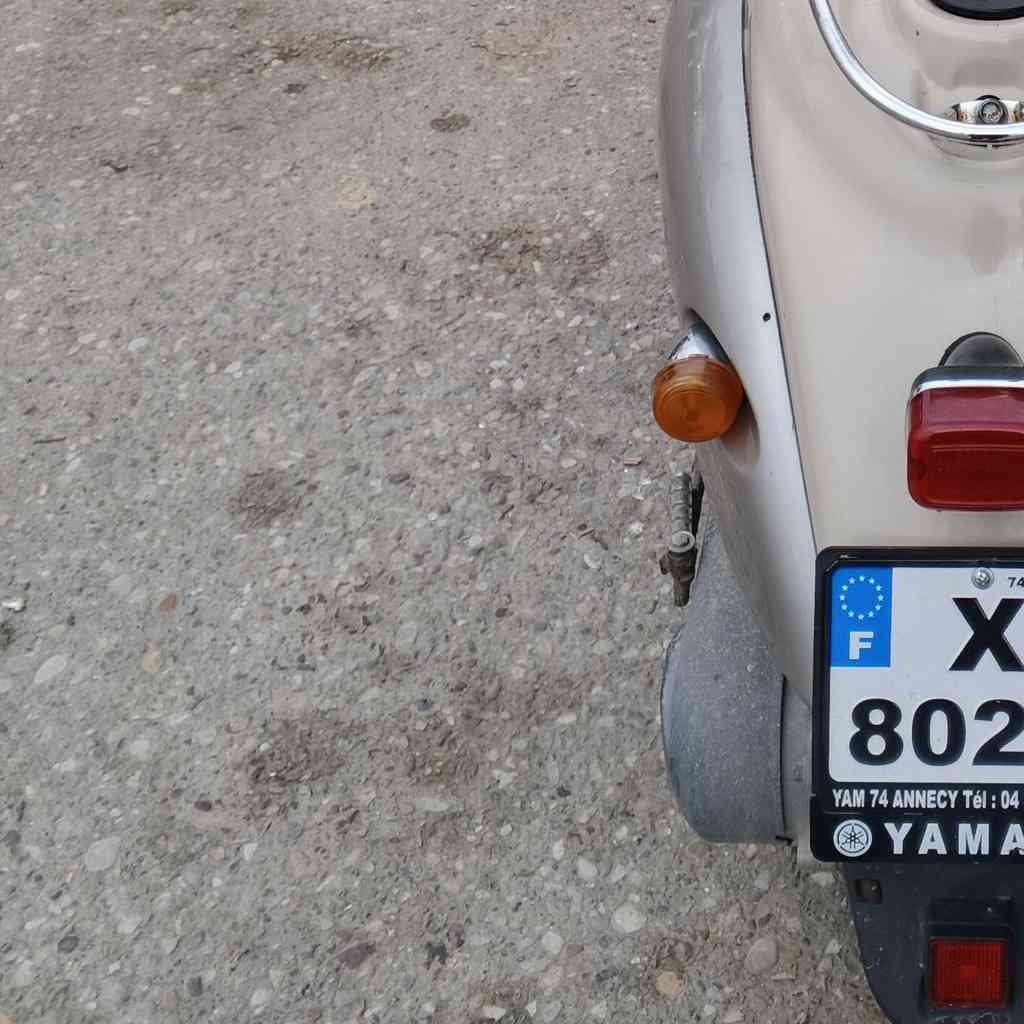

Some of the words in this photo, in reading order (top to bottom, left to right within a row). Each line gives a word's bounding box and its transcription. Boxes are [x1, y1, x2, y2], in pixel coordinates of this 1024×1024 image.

[848, 631, 874, 661] F
[832, 789, 865, 808] YAM
[869, 789, 888, 808] 74
[892, 789, 959, 809] ANNECY
[962, 790, 987, 809] Tél
[1001, 790, 1019, 809] 04
